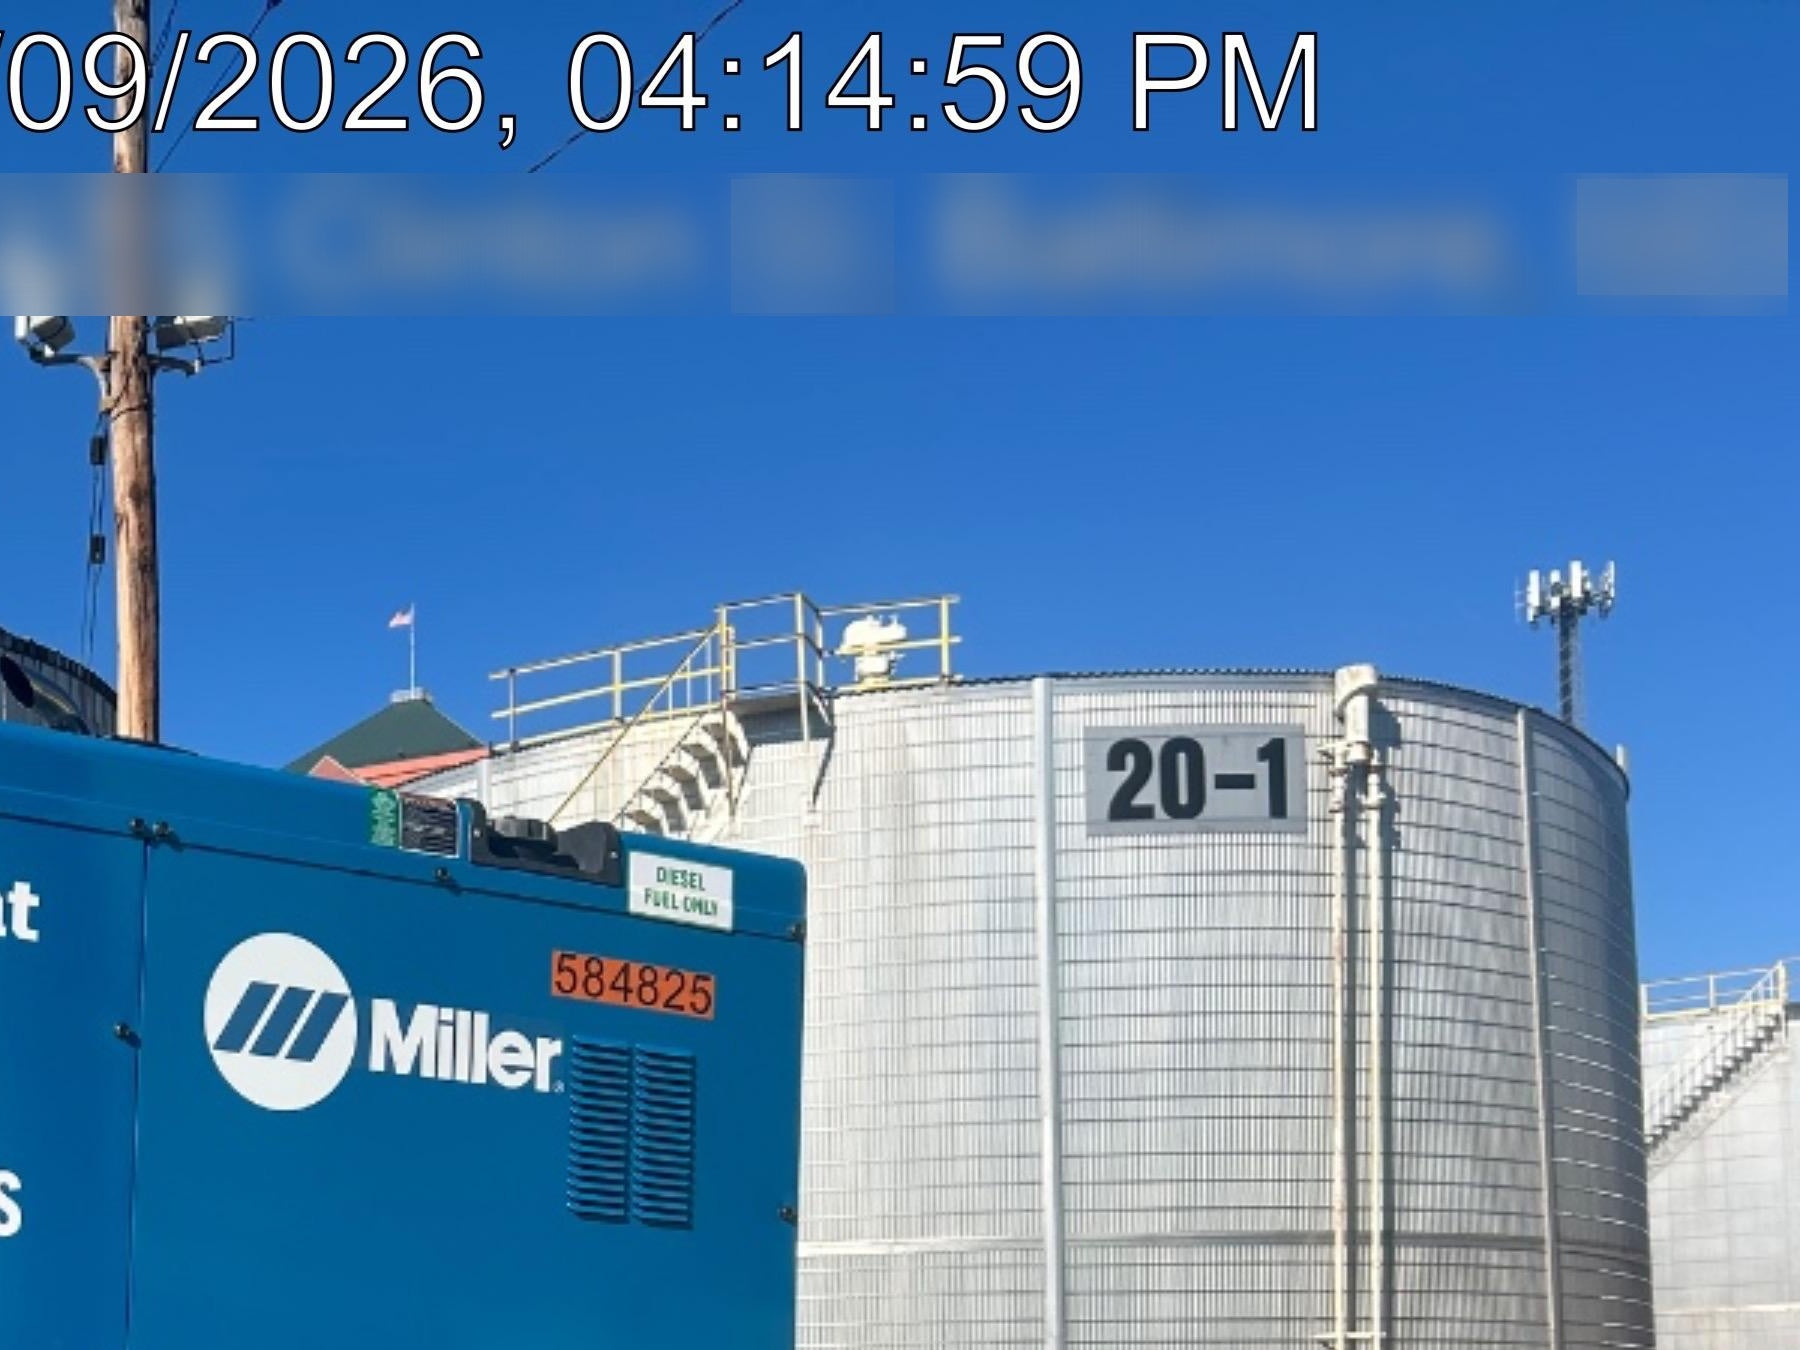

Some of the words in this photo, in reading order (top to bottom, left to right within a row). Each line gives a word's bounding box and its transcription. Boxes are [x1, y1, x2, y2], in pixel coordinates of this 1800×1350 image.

[1105, 735, 1289, 823] 20-1
[656, 866, 705, 891] DIESEL
[643, 888, 680, 910] FUEL
[682, 896, 718, 916] ONLY
[553, 953, 713, 1015] 584825
